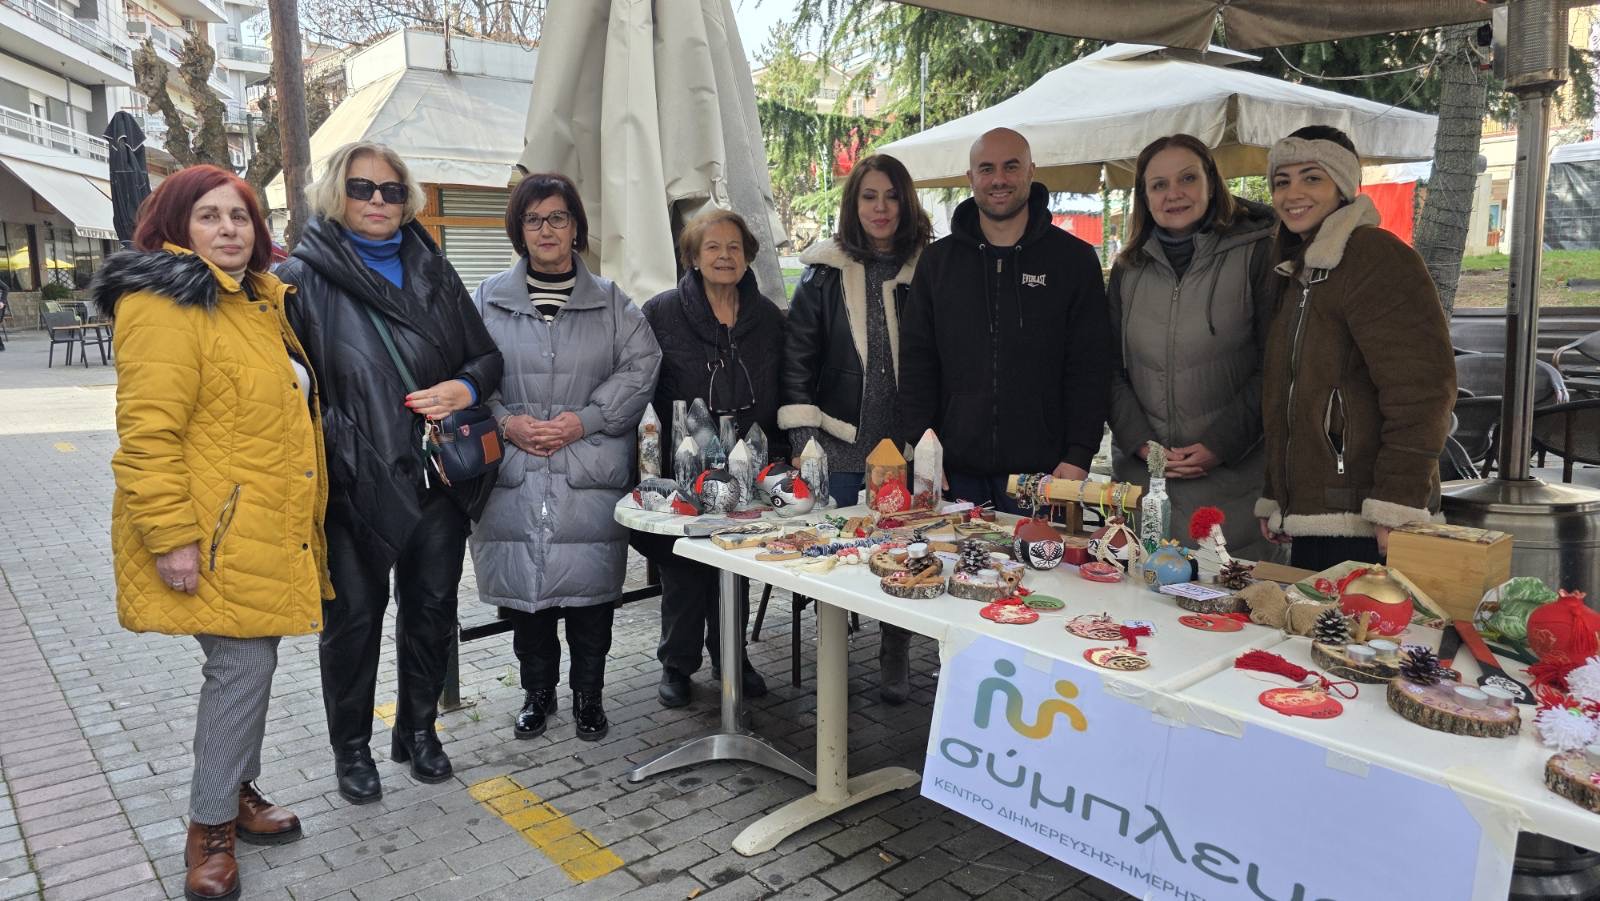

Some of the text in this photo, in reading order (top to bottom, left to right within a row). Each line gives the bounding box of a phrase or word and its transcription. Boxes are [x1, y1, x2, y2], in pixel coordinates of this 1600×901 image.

[1022, 273, 1047, 286] EVERLAST
[934, 776, 1205, 901] ΚΕΝΤΡΟ ΔΙΗΜΕΡΕΥΣΗΣ-ΗΜΕΡΗ
[939, 737, 1338, 901] σύμπλευ
